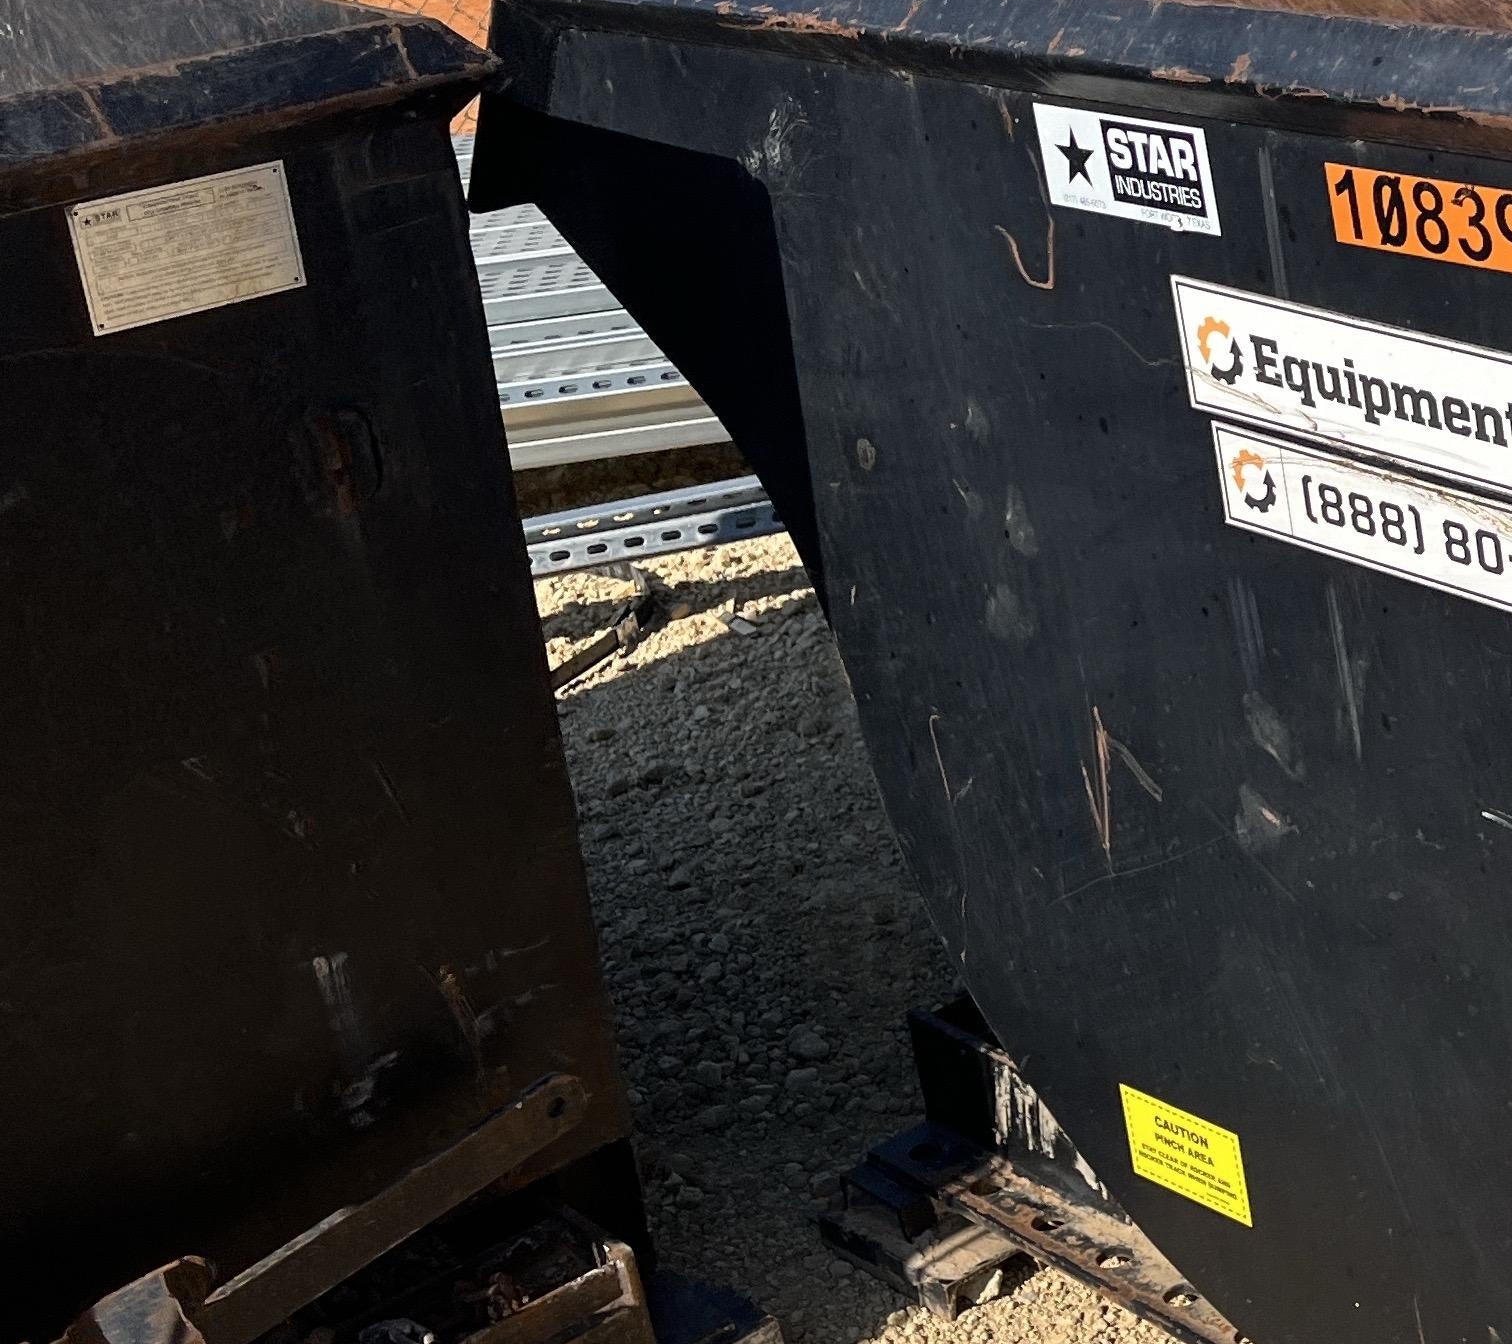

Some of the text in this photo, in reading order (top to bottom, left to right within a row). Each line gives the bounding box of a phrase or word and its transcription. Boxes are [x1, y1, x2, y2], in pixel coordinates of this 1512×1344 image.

[1106, 127, 1198, 182] STAR
[1114, 174, 1202, 209] INDUSTRIES
[1302, 474, 1425, 555] (888)
[1154, 1115, 1209, 1149] CAUTION
[1154, 1132, 1215, 1168] PINCH AREA
